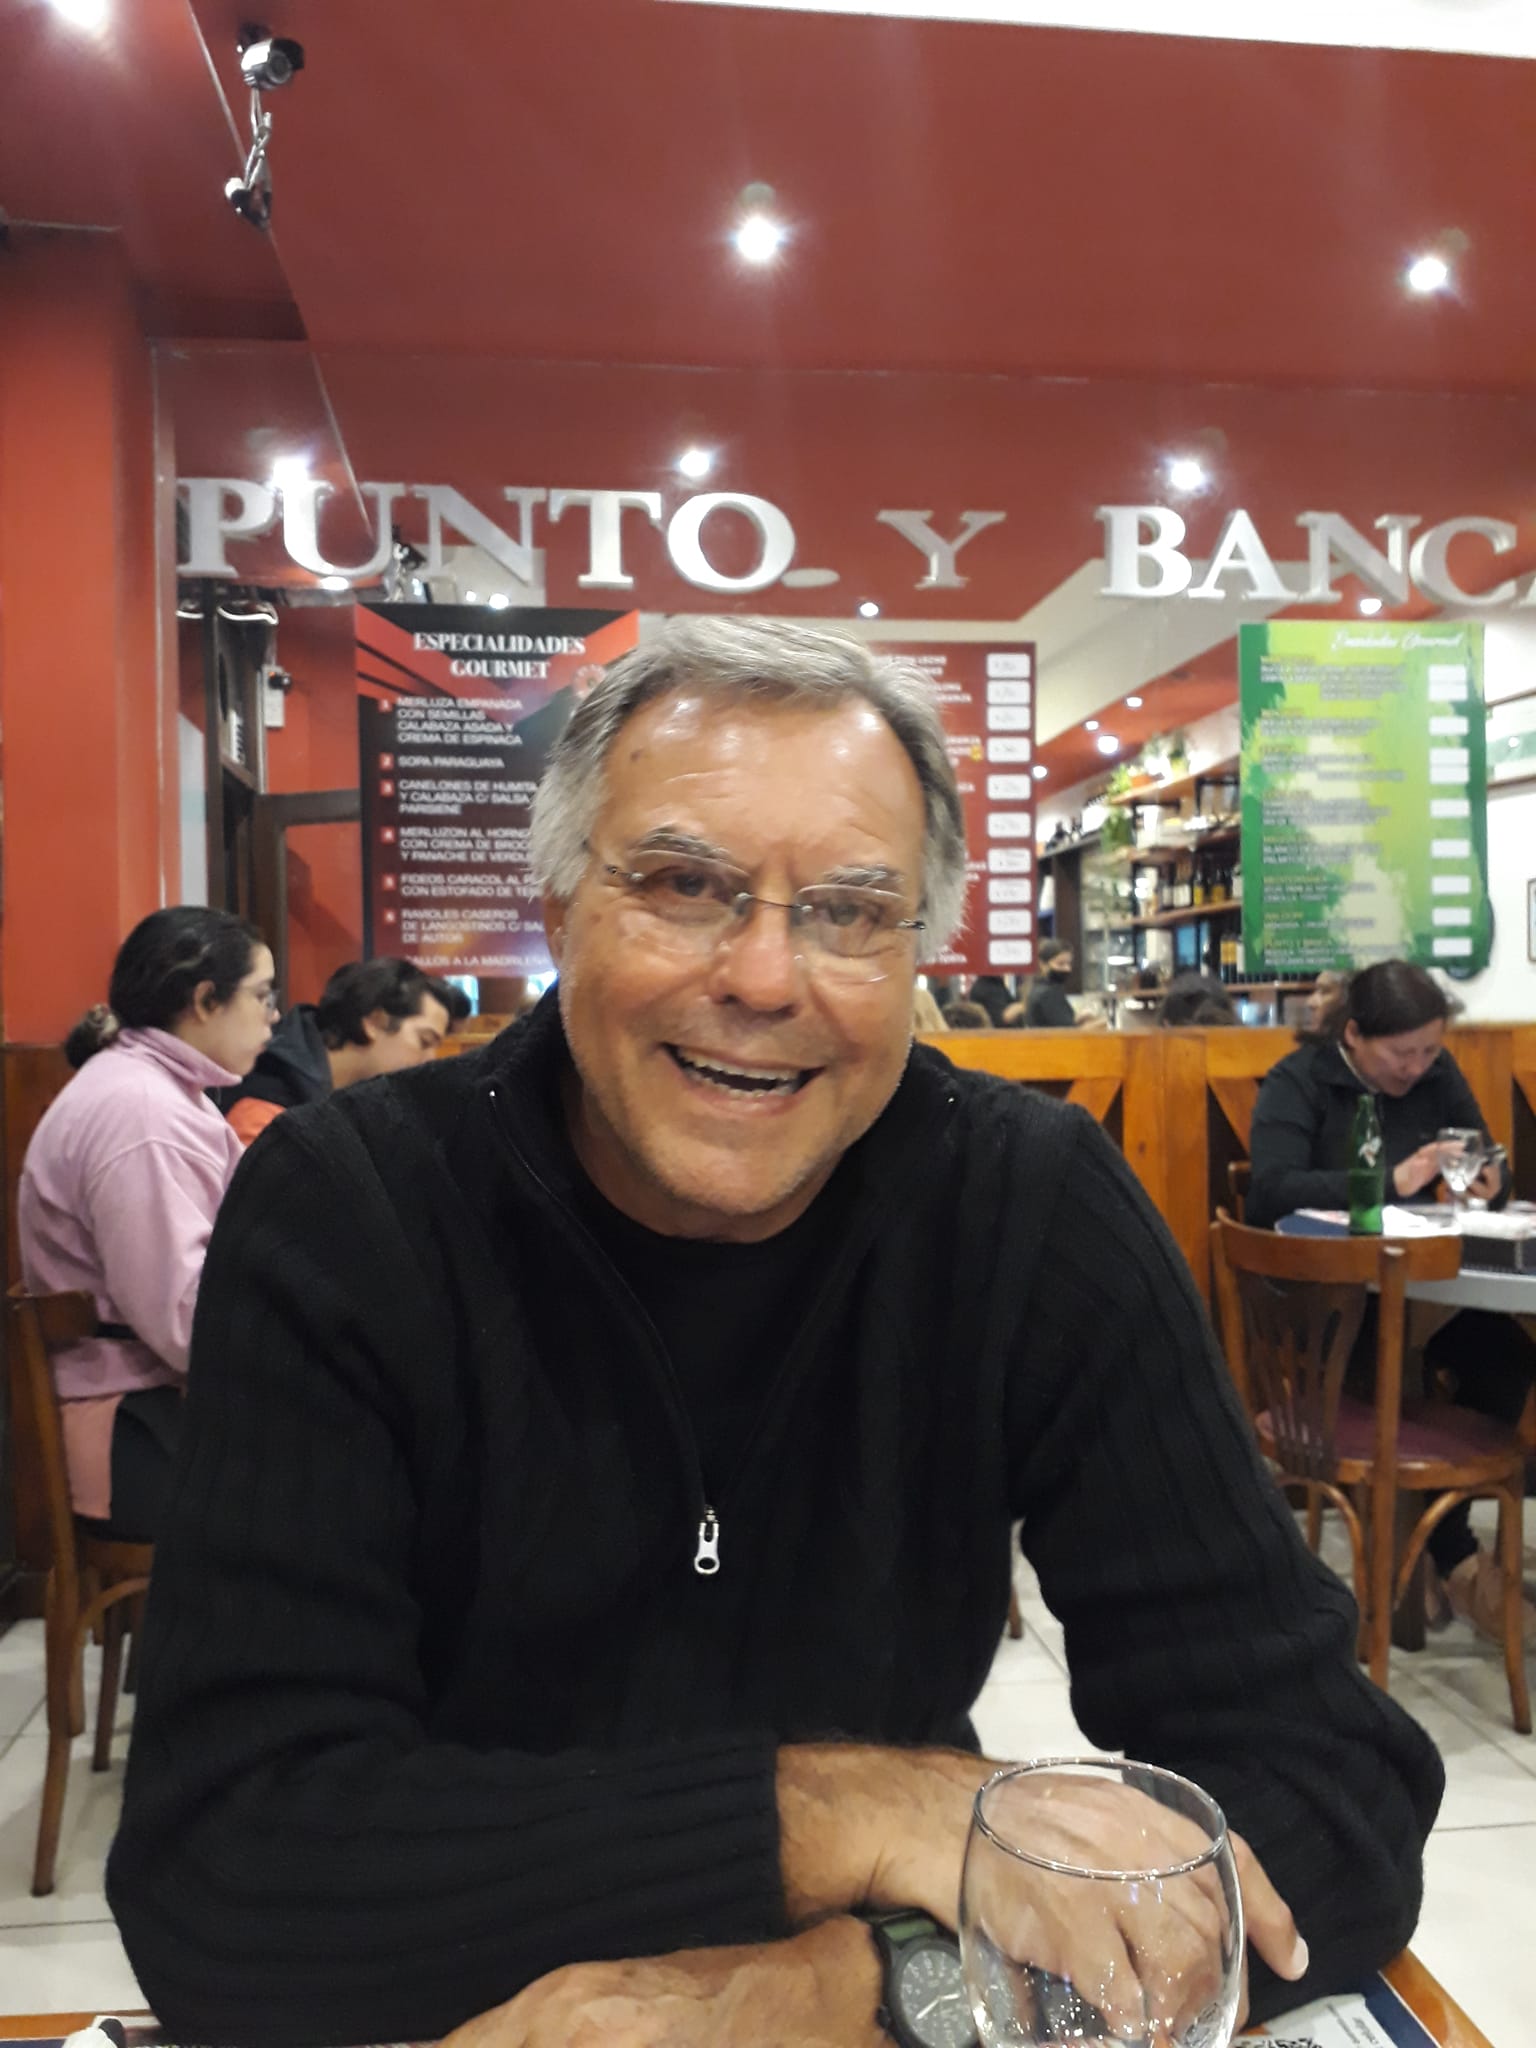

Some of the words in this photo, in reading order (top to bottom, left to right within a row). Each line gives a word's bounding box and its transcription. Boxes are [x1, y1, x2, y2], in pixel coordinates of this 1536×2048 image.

[176, 477, 796, 593] PUNTO
[877, 509, 1007, 590] Y
[1094, 504, 1536, 607] BANC
[414, 632, 586, 654] ESPECIALIDADES
[450, 659, 550, 679] GOURMET
[398, 697, 455, 708] MERLUZA
[457, 699, 523, 710] EMPANADA
[398, 709, 425, 719] CON
[428, 710, 486, 721] SEMILLAS
[398, 721, 461, 732] CALABAZA
[463, 721, 503, 732] ASADA
[506, 723, 514, 732] Y
[398, 733, 442, 744] CREMA
[444, 733, 460, 744] DE
[462, 734, 523, 745] ESPINACA
[399, 756, 432, 768] SOPA
[433, 757, 505, 769] PARAGUAYA
[399, 779, 472, 791] CANELONES
[474, 781, 491, 791] DE
[400, 791, 409, 802] Y
[411, 792, 473, 803] CALABAZA
[470, 828, 484, 839] AL
[400, 839, 427, 850] CON
[430, 839, 473, 850] CREMA
[477, 840, 491, 850] DE
[401, 851, 409, 861] Y
[412, 851, 466, 862] PANACHE
[471, 852, 487, 862] DE
[401, 873, 445, 884] FIDEOS
[447, 874, 502, 885] CARACOL
[507, 875, 521, 885] AL
[402, 885, 429, 897] CON
[432, 886, 494, 897] ESTOFADO
[497, 886, 513, 897] DE
[402, 909, 459, 919] RAVIOLES
[462, 909, 519, 920] CASEROS
[403, 920, 417, 931] DE
[421, 920, 505, 932] LANGOSTINOS
[403, 933, 417, 943] DE
[421, 932, 464, 943] AUTOR
[454, 955, 462, 965] A
[464, 955, 480, 966] LA
